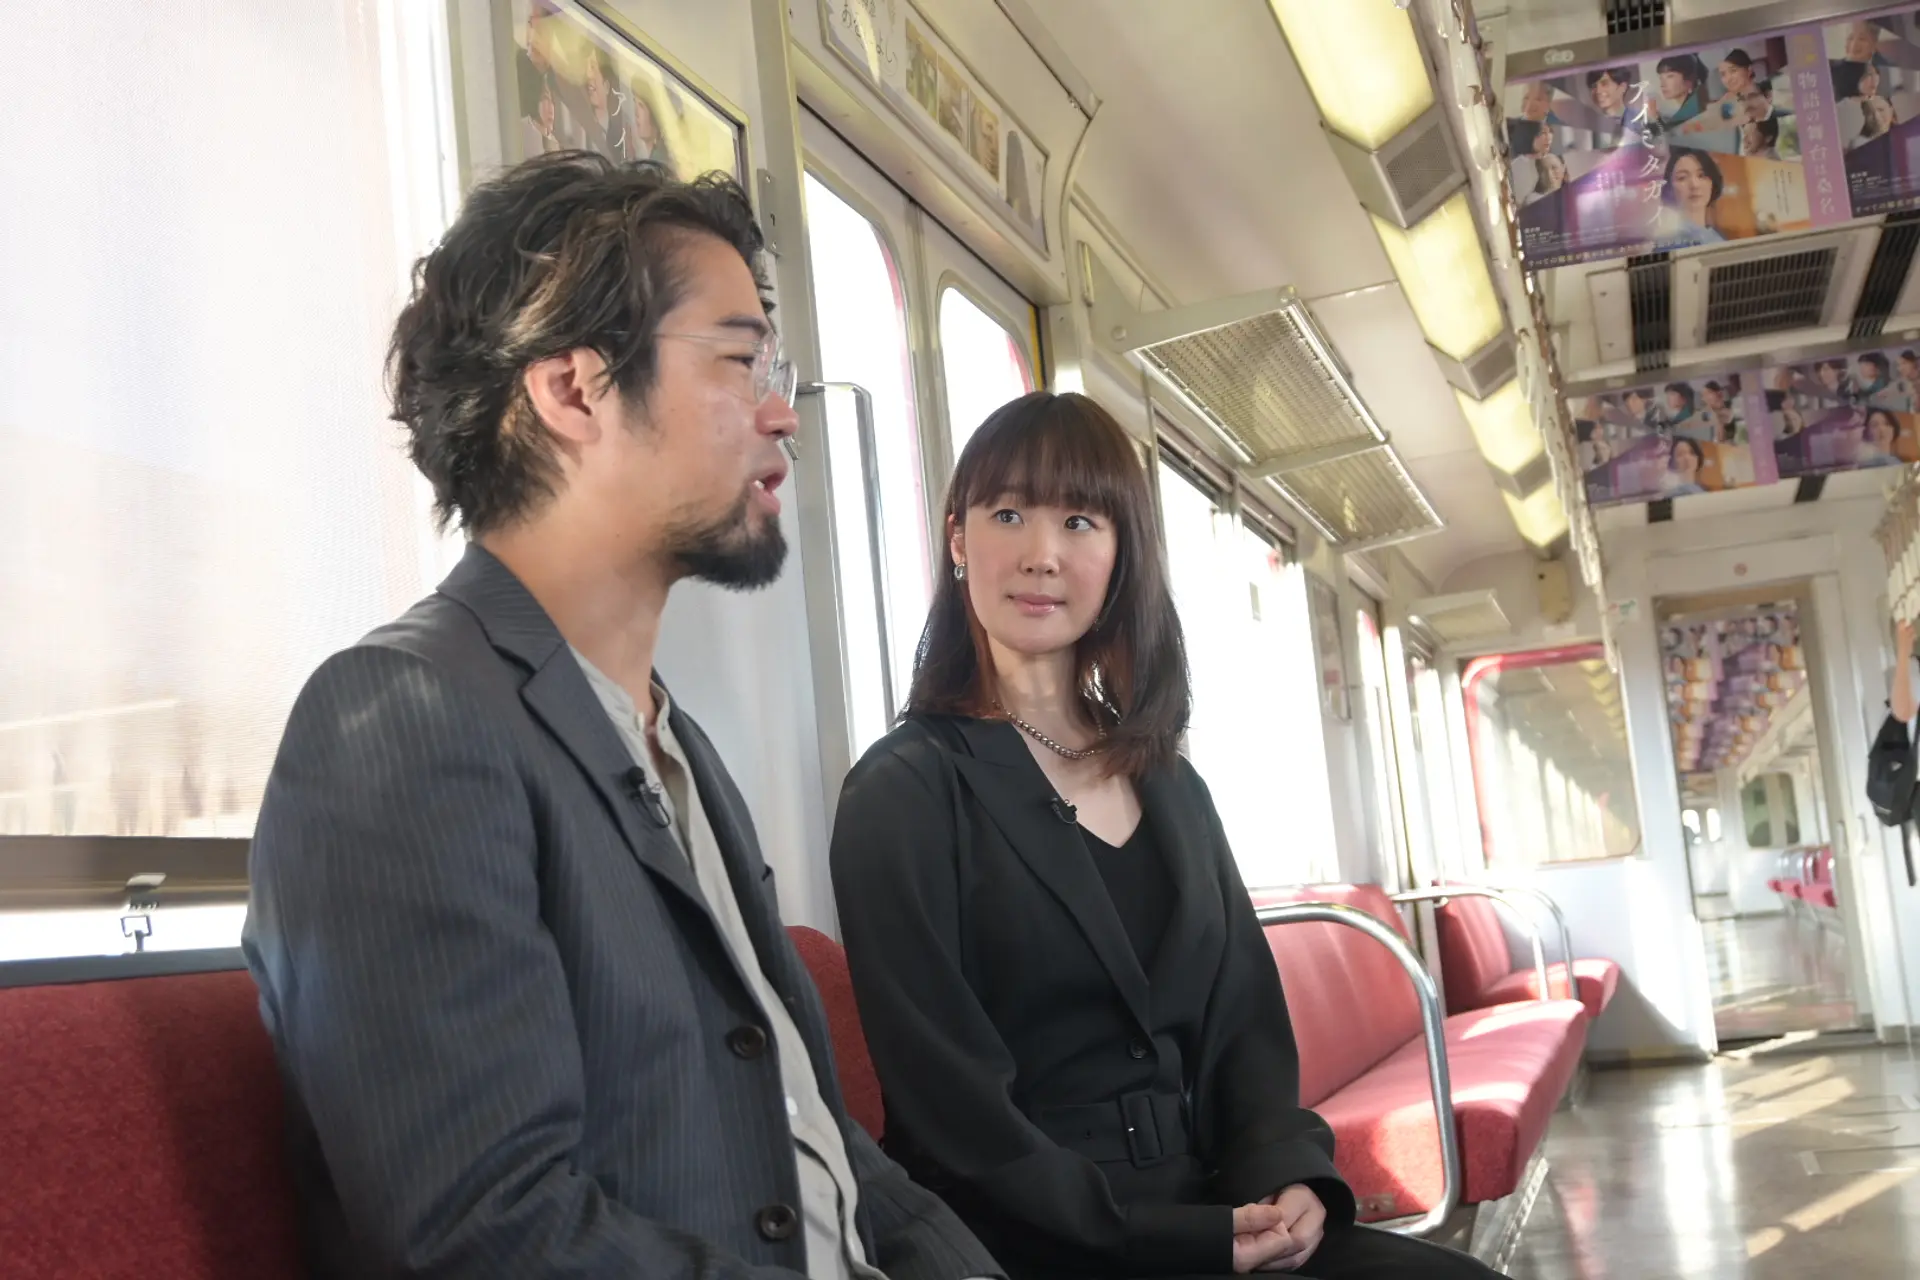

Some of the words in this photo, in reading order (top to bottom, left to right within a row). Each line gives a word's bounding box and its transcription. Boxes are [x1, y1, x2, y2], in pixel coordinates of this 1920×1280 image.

[1628, 80, 1667, 226] アイミタガイ
